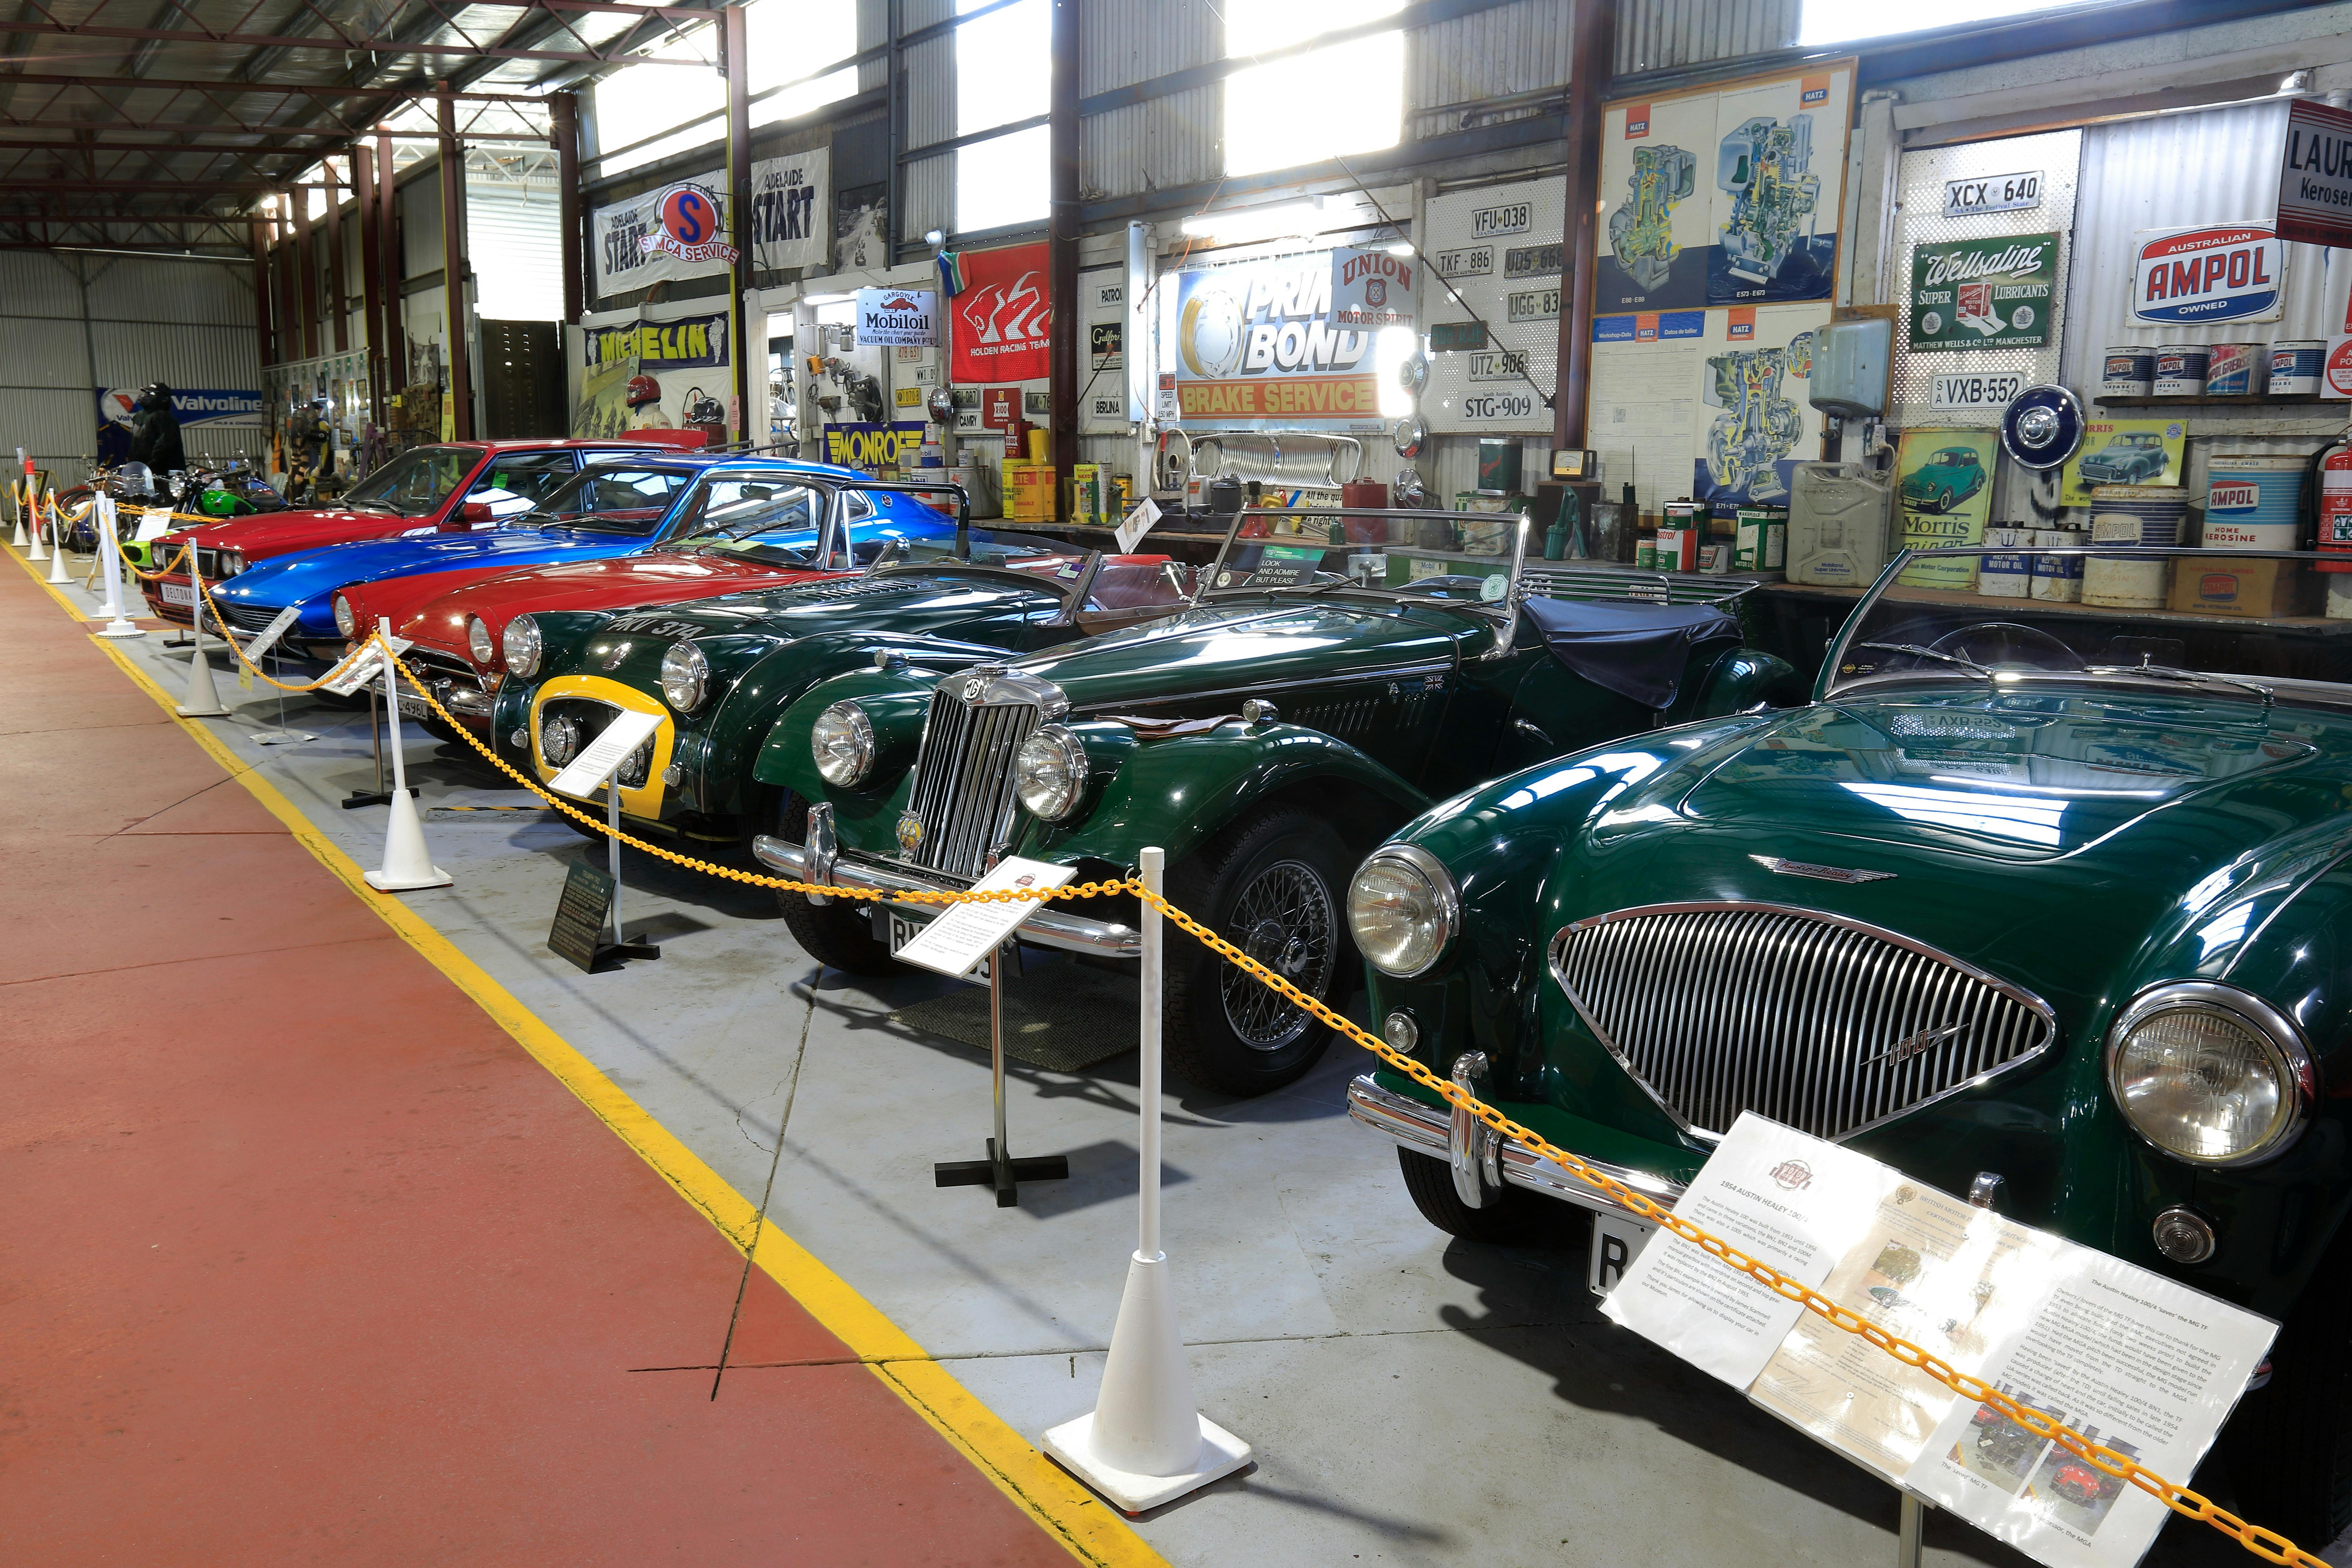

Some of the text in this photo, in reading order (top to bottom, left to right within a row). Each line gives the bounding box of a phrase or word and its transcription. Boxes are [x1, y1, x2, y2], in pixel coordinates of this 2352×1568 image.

[1805, 90, 1825, 101] HATZ
[1629, 122, 1646, 132] HATZ
[765, 168, 804, 191] ADELAIDE
[1950, 177, 2037, 208] XCX 640
[611, 209, 638, 230] ADELAIDE
[679, 194, 700, 243] S
[753, 185, 814, 244] START
[2167, 232, 2252, 254] AUSTRALIAN
[686, 244, 738, 264] SERVICE
[1342, 253, 1412, 291] UNION
[2146, 246, 2270, 302] AMPOL
[883, 292, 915, 302] GARGOYLE
[1918, 284, 2049, 305] SUPER LUBRICANTS
[2178, 300, 2228, 315] OWNED
[866, 313, 930, 329] Mobiloil
[1337, 310, 1413, 327] MOTOR SPIRIT
[600, 323, 707, 362] MICHELIN
[970, 347, 999, 356] HOLDEN
[1000, 343, 1027, 354] RACING
[1246, 319, 1369, 369] BOND
[1913, 340, 1942, 350] MATTHEW
[1945, 340, 1964, 348] WELLS
[1996, 336, 2042, 345] MANCHESTER
[2159, 361, 2181, 371] AMPOL
[171, 396, 262, 411] Valvoline
[1182, 382, 1374, 413] BRAKE SERVICE
[1096, 401, 1120, 414] BERLINA
[1465, 397, 1531, 417] STG-909
[959, 415, 977, 427] CAMRY
[1305, 491, 1329, 500] All the
[2211, 490, 2253, 506] AMPOL
[1901, 514, 1970, 535] Morris
[2095, 524, 2136, 539] AMPOL
[2205, 533, 2256, 542] KEROSINE
[1989, 561, 2010, 569] MOTOR
[2203, 583, 2235, 594] AMPOL
[606, 618, 705, 640] PKV 374
[965, 681, 978, 696] MG
[1780, 862, 1854, 877] Austin-Healey
[1889, 1029, 1927, 1066] 100
[1720, 1180, 1809, 1223] 1954 AUSTIN HEALEY 100/4
[1919, 1195, 1970, 1222] BRITISH MOTOR
[1926, 1211, 1960, 1226] CERTIFIED
[1649, 1285, 1668, 1297] Museum.
[1646, 1274, 1659, 1284] Thank
[1668, 1285, 1680, 1295] James
[1688, 1296, 1706, 1309] allowing
[1719, 1312, 1735, 1324] display
[1734, 1320, 1746, 1329] your
[2091, 1279, 2102, 1287] The
[2102, 1283, 2120, 1294] Austin
[2120, 1291, 2140, 1303] Healey
[2139, 1299, 2157, 1310] 100/4
[2177, 1315, 2188, 1323] the
[2188, 1319, 2200, 1327] MG
[1941, 1461, 1952, 1471] The
[1969, 1478, 1981, 1486] MG
[2066, 1531, 2092, 1548] the MGA
